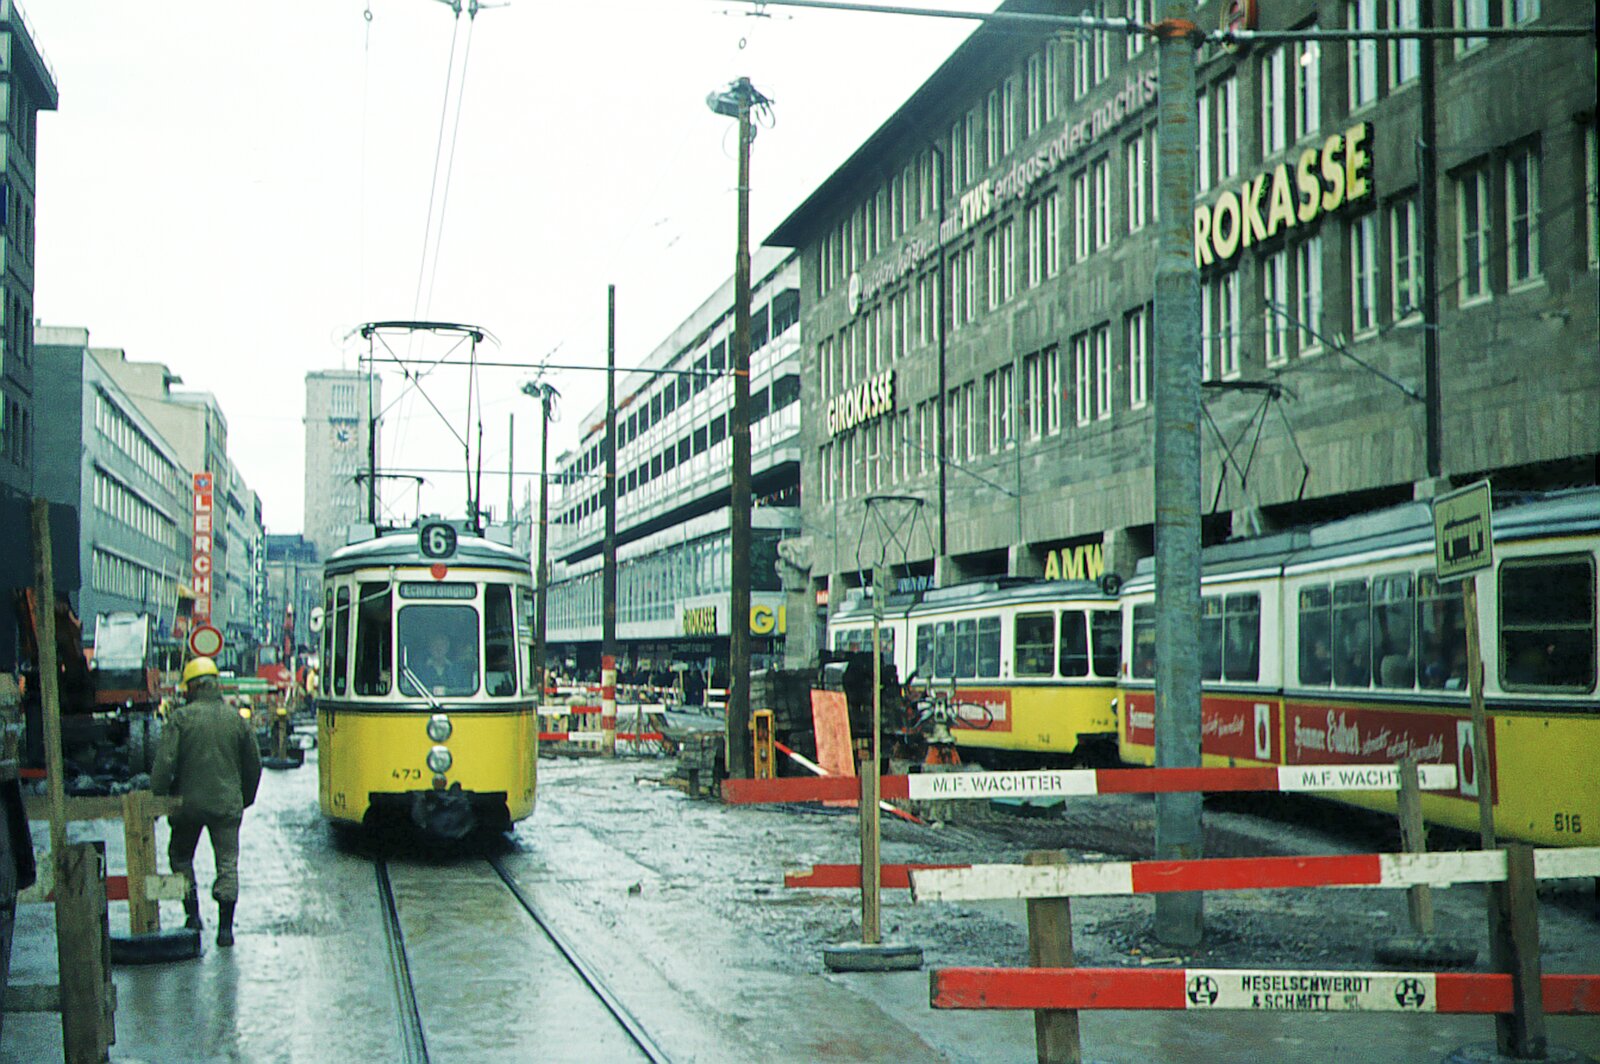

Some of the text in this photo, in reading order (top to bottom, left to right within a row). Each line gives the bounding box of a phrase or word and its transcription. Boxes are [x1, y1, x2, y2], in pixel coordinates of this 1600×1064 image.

[961, 180, 991, 231] TWS
[827, 370, 893, 437] GIROKASSE
[194, 493, 210, 614] LERCHE
[429, 526, 447, 554] 6
[1044, 543, 1104, 582] AMW
[750, 604, 786, 635] GI
[933, 775, 1062, 792] M.F. WACHTER
[1302, 770, 1427, 786] M.F. WACHTR
[1553, 812, 1582, 833] 616
[1241, 975, 1371, 992] HESELSCHWERDT
[1264, 994, 1330, 1011] SCHMITT
